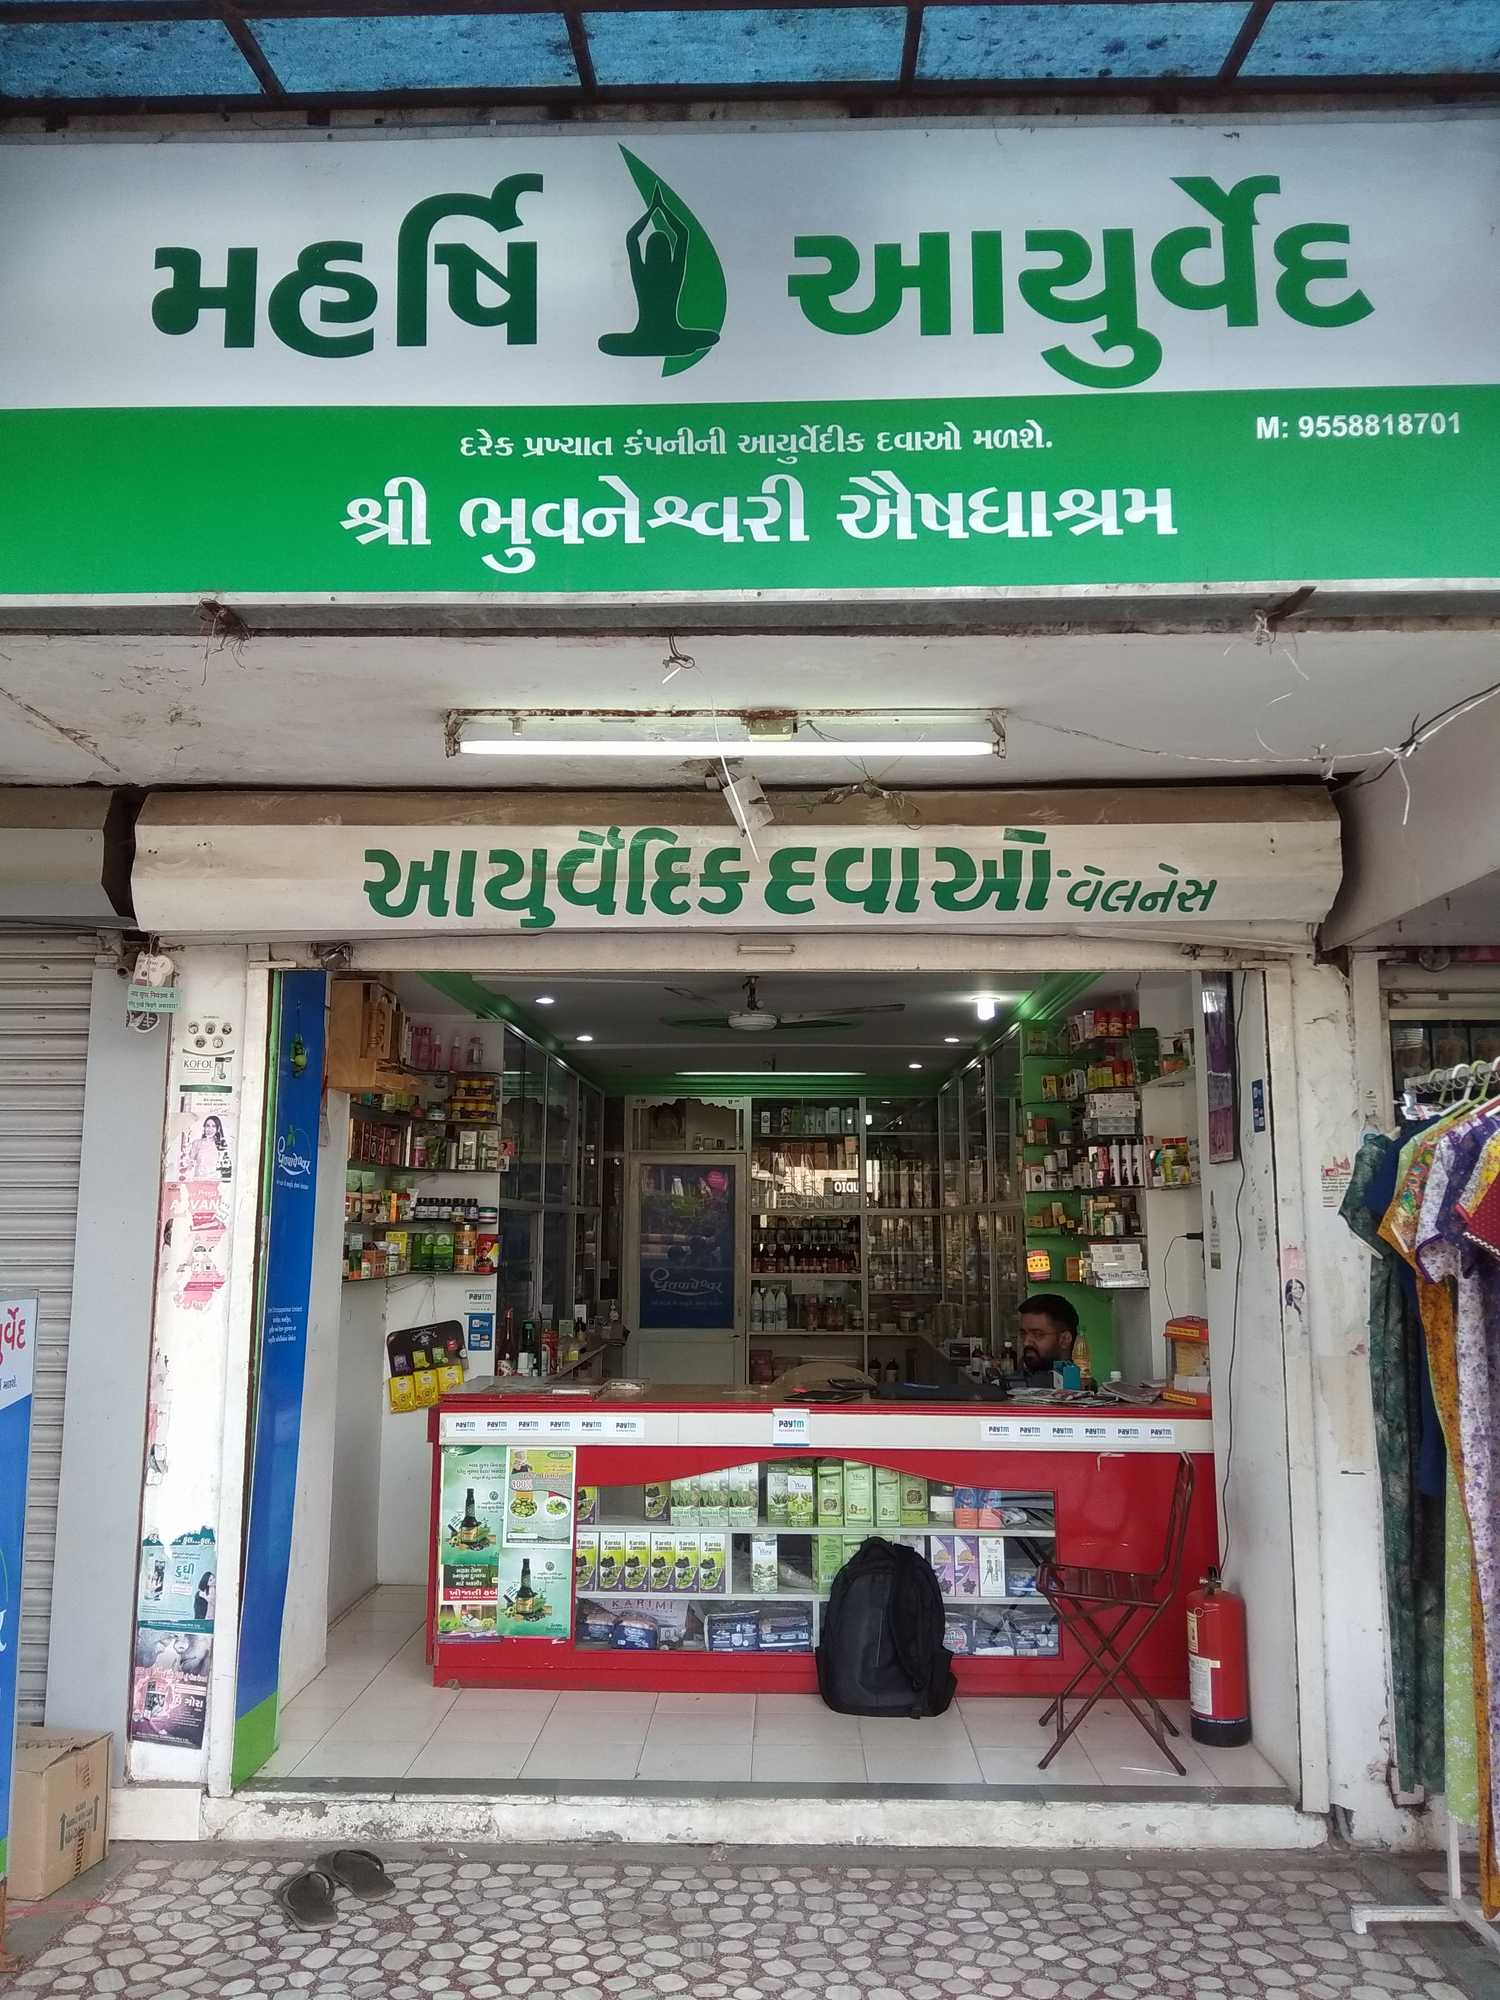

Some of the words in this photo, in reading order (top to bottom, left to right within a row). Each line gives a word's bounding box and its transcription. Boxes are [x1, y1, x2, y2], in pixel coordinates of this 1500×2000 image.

[151, 172, 544, 359] મહર્ષિ
[787, 174, 1376, 389] આયુર્વેદ
[460, 428, 514, 457] દરેક
[522, 436, 613, 458] પ્રખ્યાત
[624, 426, 727, 456] કંપનીની
[738, 424, 865, 464] આયુર્વેદીક
[877, 421, 962, 452] દવાઓ
[972, 419, 1053, 449] મળશે.
[1256, 416, 1289, 440] M:
[1299, 412, 1461, 438] 9558818701
[339, 476, 432, 546] શ્રી
[459, 473, 810, 574] ભુવનેશ્વરી
[764, 827, 1051, 914] દવાઓ
[183, 1059, 214, 1069] KOFOL
[778, 1419, 805, 1428] Paytm
